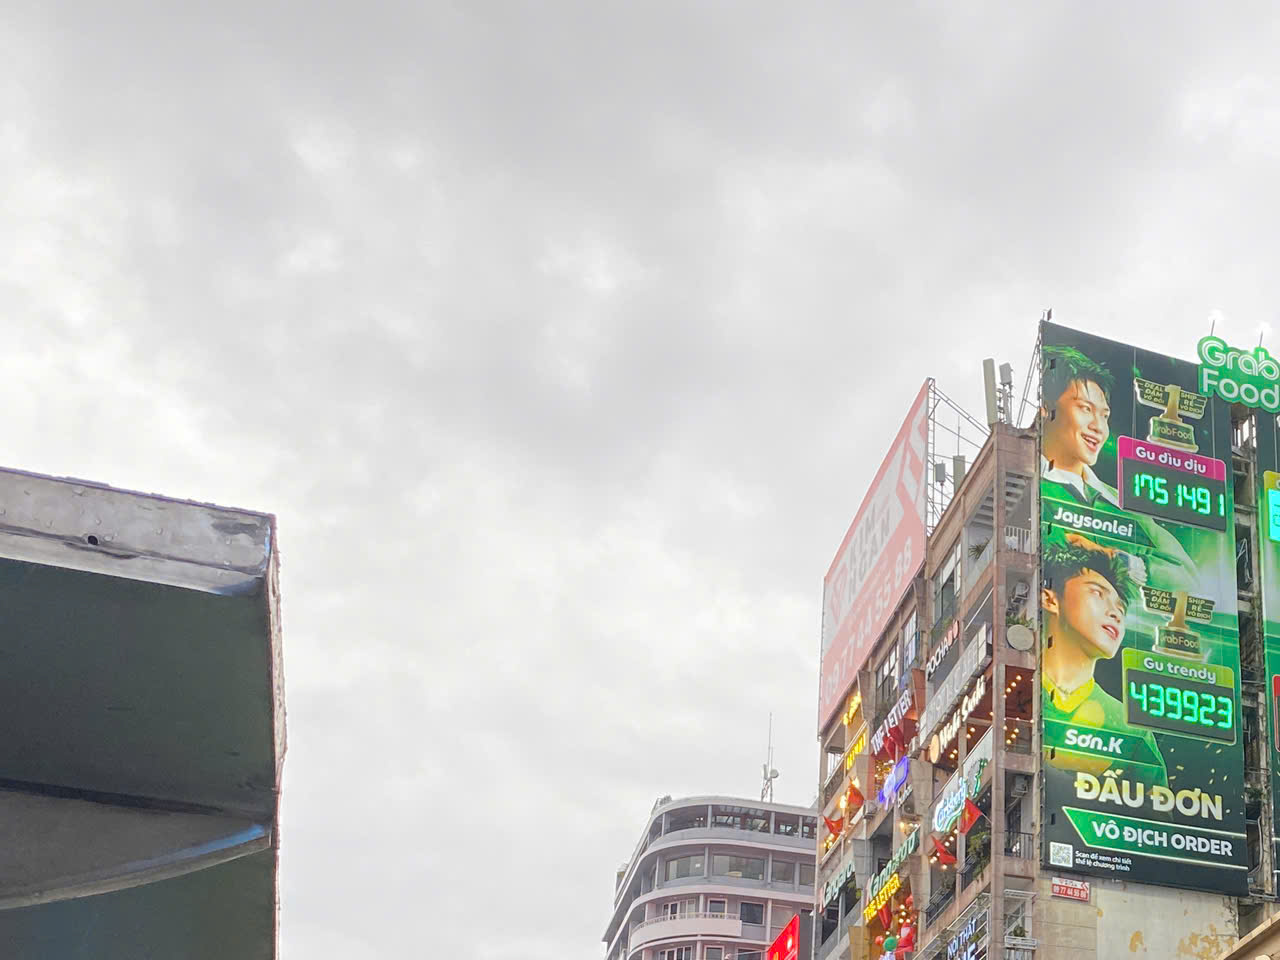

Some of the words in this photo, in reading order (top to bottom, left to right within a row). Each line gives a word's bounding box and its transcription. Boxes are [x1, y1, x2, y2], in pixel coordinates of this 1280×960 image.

[1202, 341, 1280, 380] Grab
[1203, 368, 1280, 409] Food
[1136, 447, 1155, 461] Gu
[1054, 507, 1133, 537] Jaysonlei
[1151, 589, 1173, 598] DEAL
[1188, 597, 1206, 605] SHIP
[1143, 657, 1164, 671] Gu
[1168, 661, 1216, 685] trendy
[1130, 681, 1233, 729] 439923
[1065, 729, 1124, 754] Sơn.K
[1074, 769, 1145, 808] ĐẤU
[1150, 785, 1223, 821] ĐƠN
[1091, 820, 1120, 840] VÔ
[1123, 828, 1168, 848] ĐỊCH
[1171, 834, 1233, 856] ORDER
[1075, 850, 1090, 859] Scan
